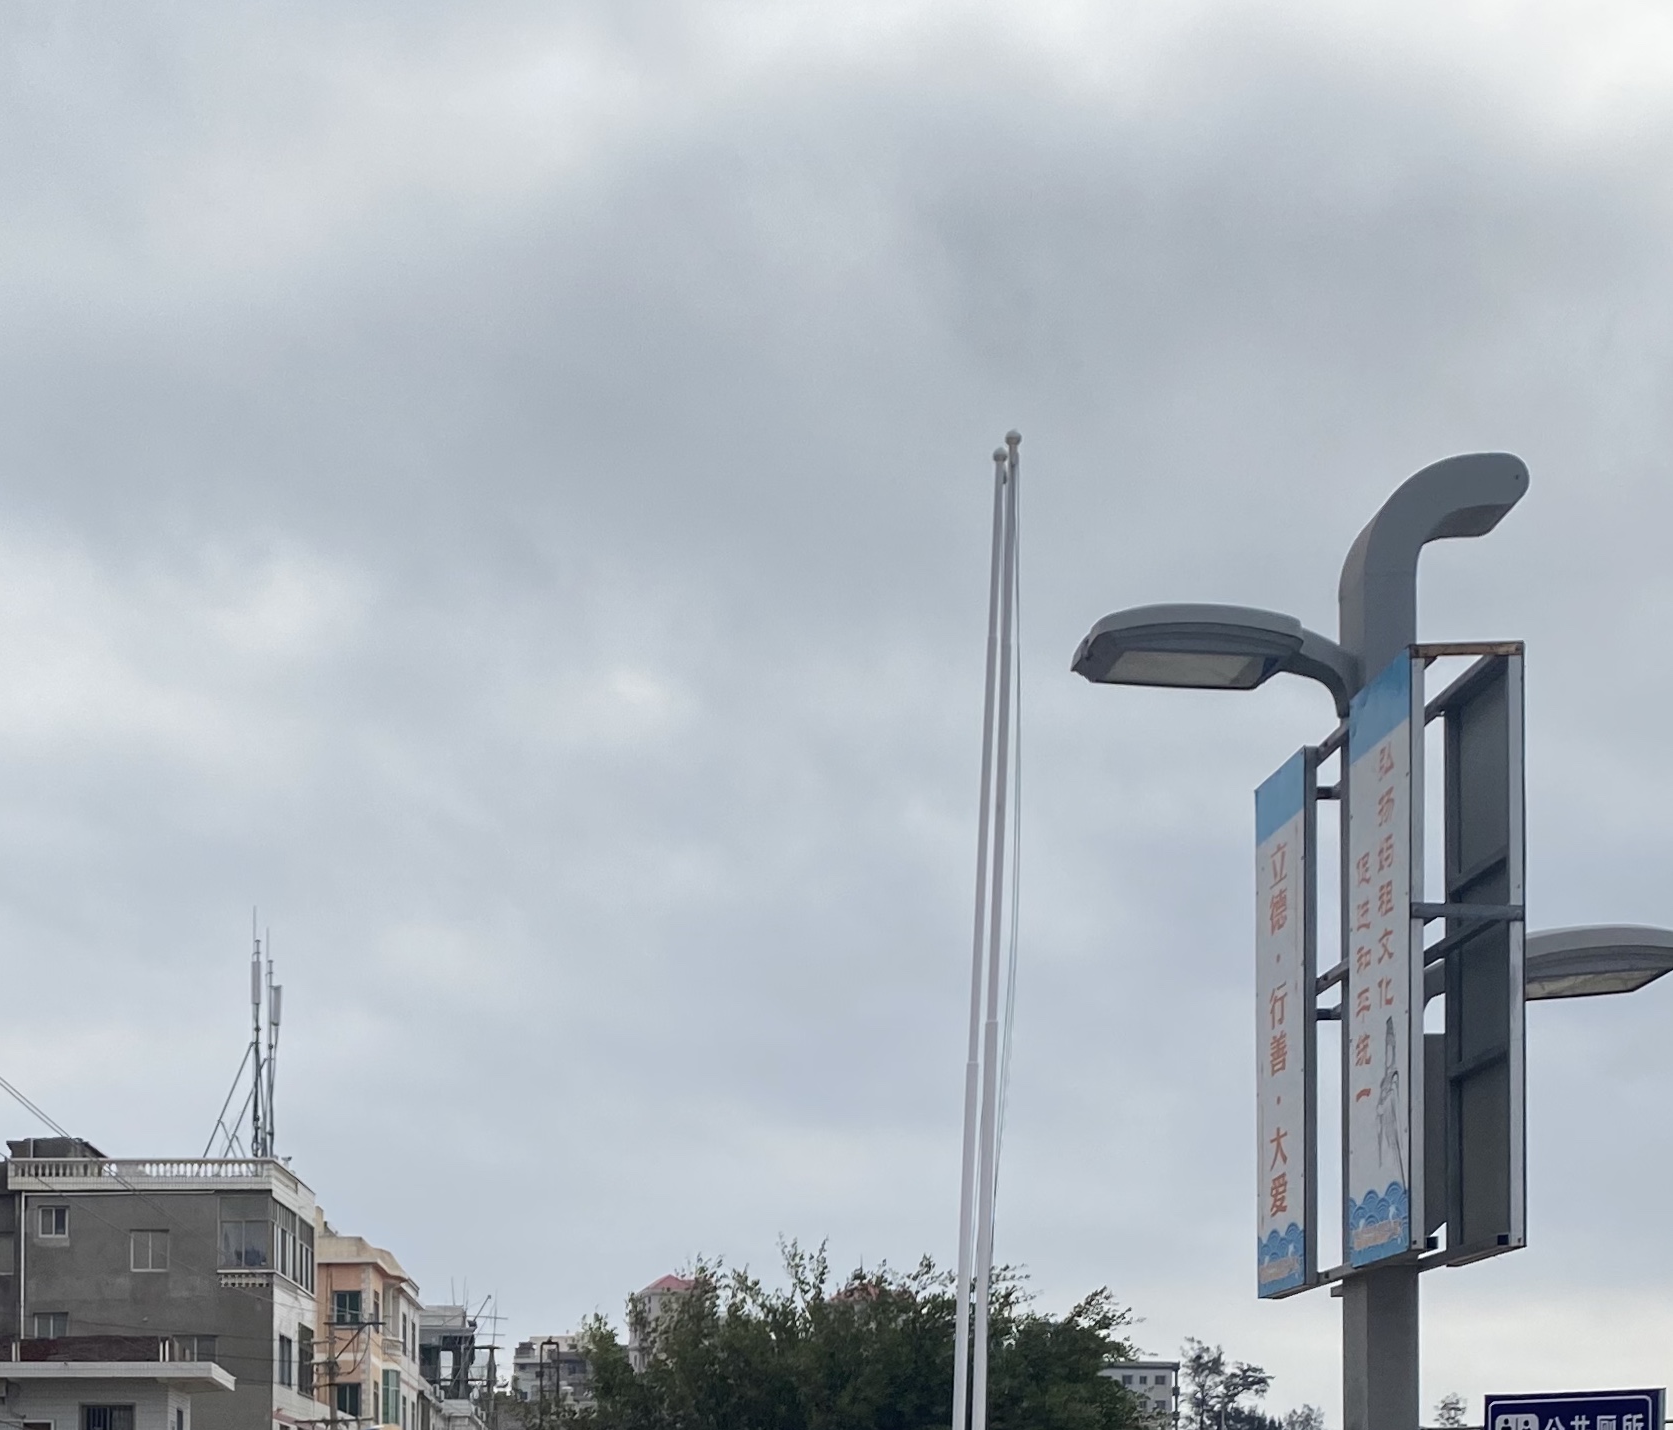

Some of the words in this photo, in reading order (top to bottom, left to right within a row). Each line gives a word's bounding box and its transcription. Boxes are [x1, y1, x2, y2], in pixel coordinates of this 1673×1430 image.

[1354, 851, 1373, 1104] 促进和平统一
